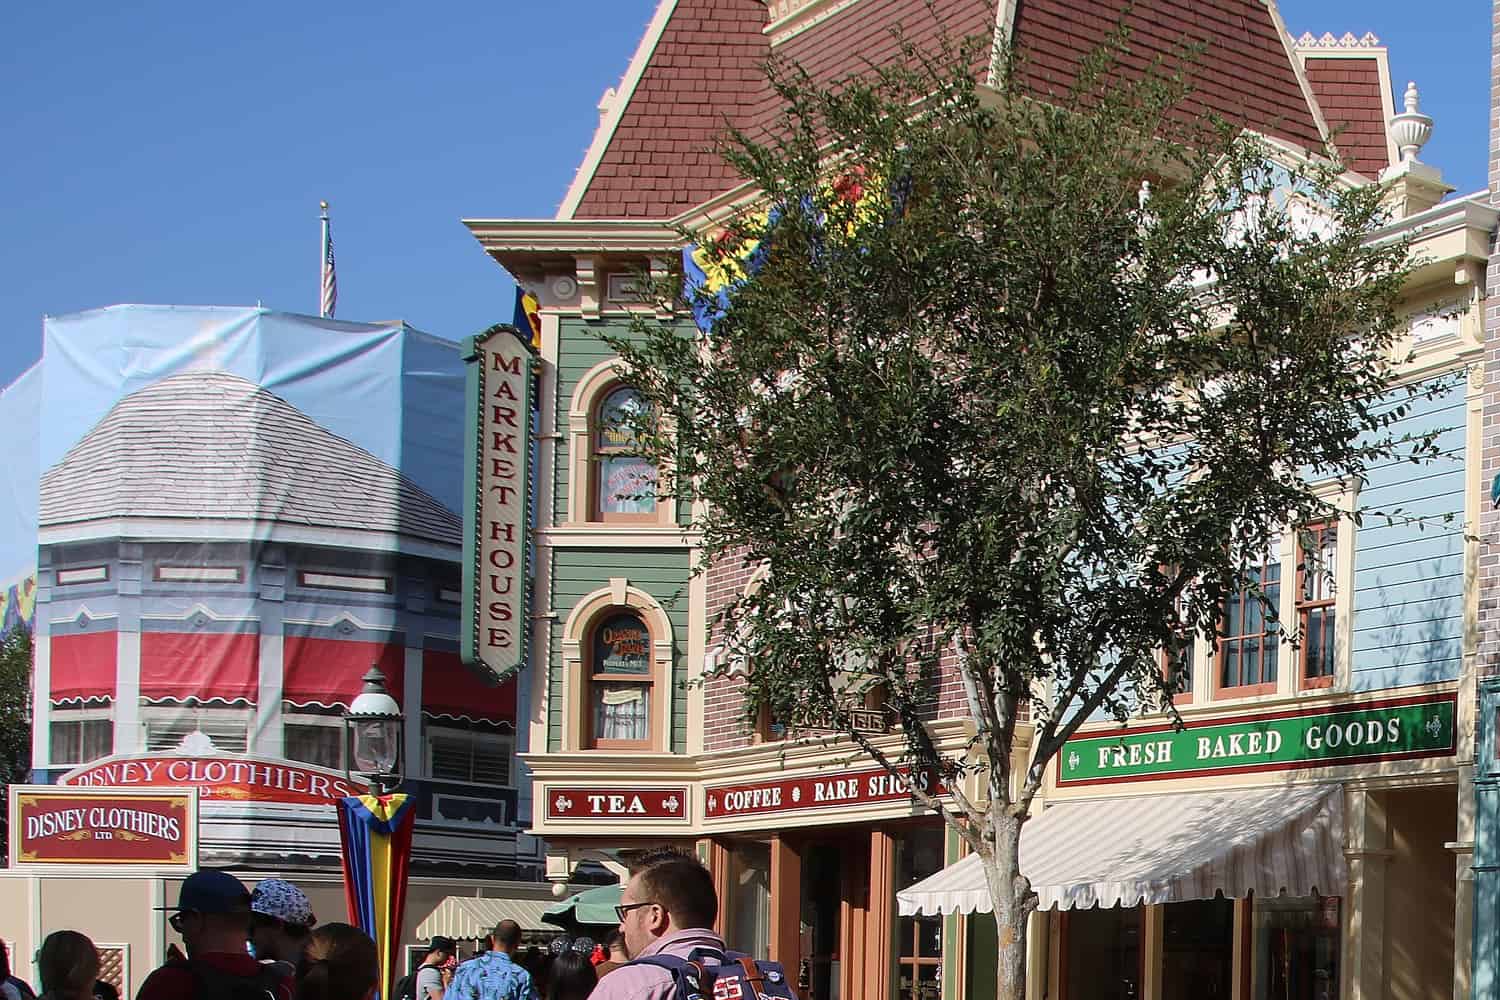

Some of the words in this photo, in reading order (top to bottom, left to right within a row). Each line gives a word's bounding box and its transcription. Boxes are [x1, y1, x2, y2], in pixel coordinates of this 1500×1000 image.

[490, 352, 521, 505] MARKET
[488, 519, 515, 648] HOUSE
[1097, 740, 1173, 770] FRESH
[1197, 730, 1282, 761] BAKED
[1305, 718, 1401, 751] GOODS
[168, 760, 352, 799] CLOTHIERS
[724, 786, 781, 811] COFFEE
[814, 777, 858, 802] RARE
[868, 771, 928, 797] SPICS
[588, 795, 647, 814] TEA
[27, 808, 86, 840] DISNEY
[90, 807, 180, 842] CLOTHIERS
[95, 831, 113, 840] LTD
